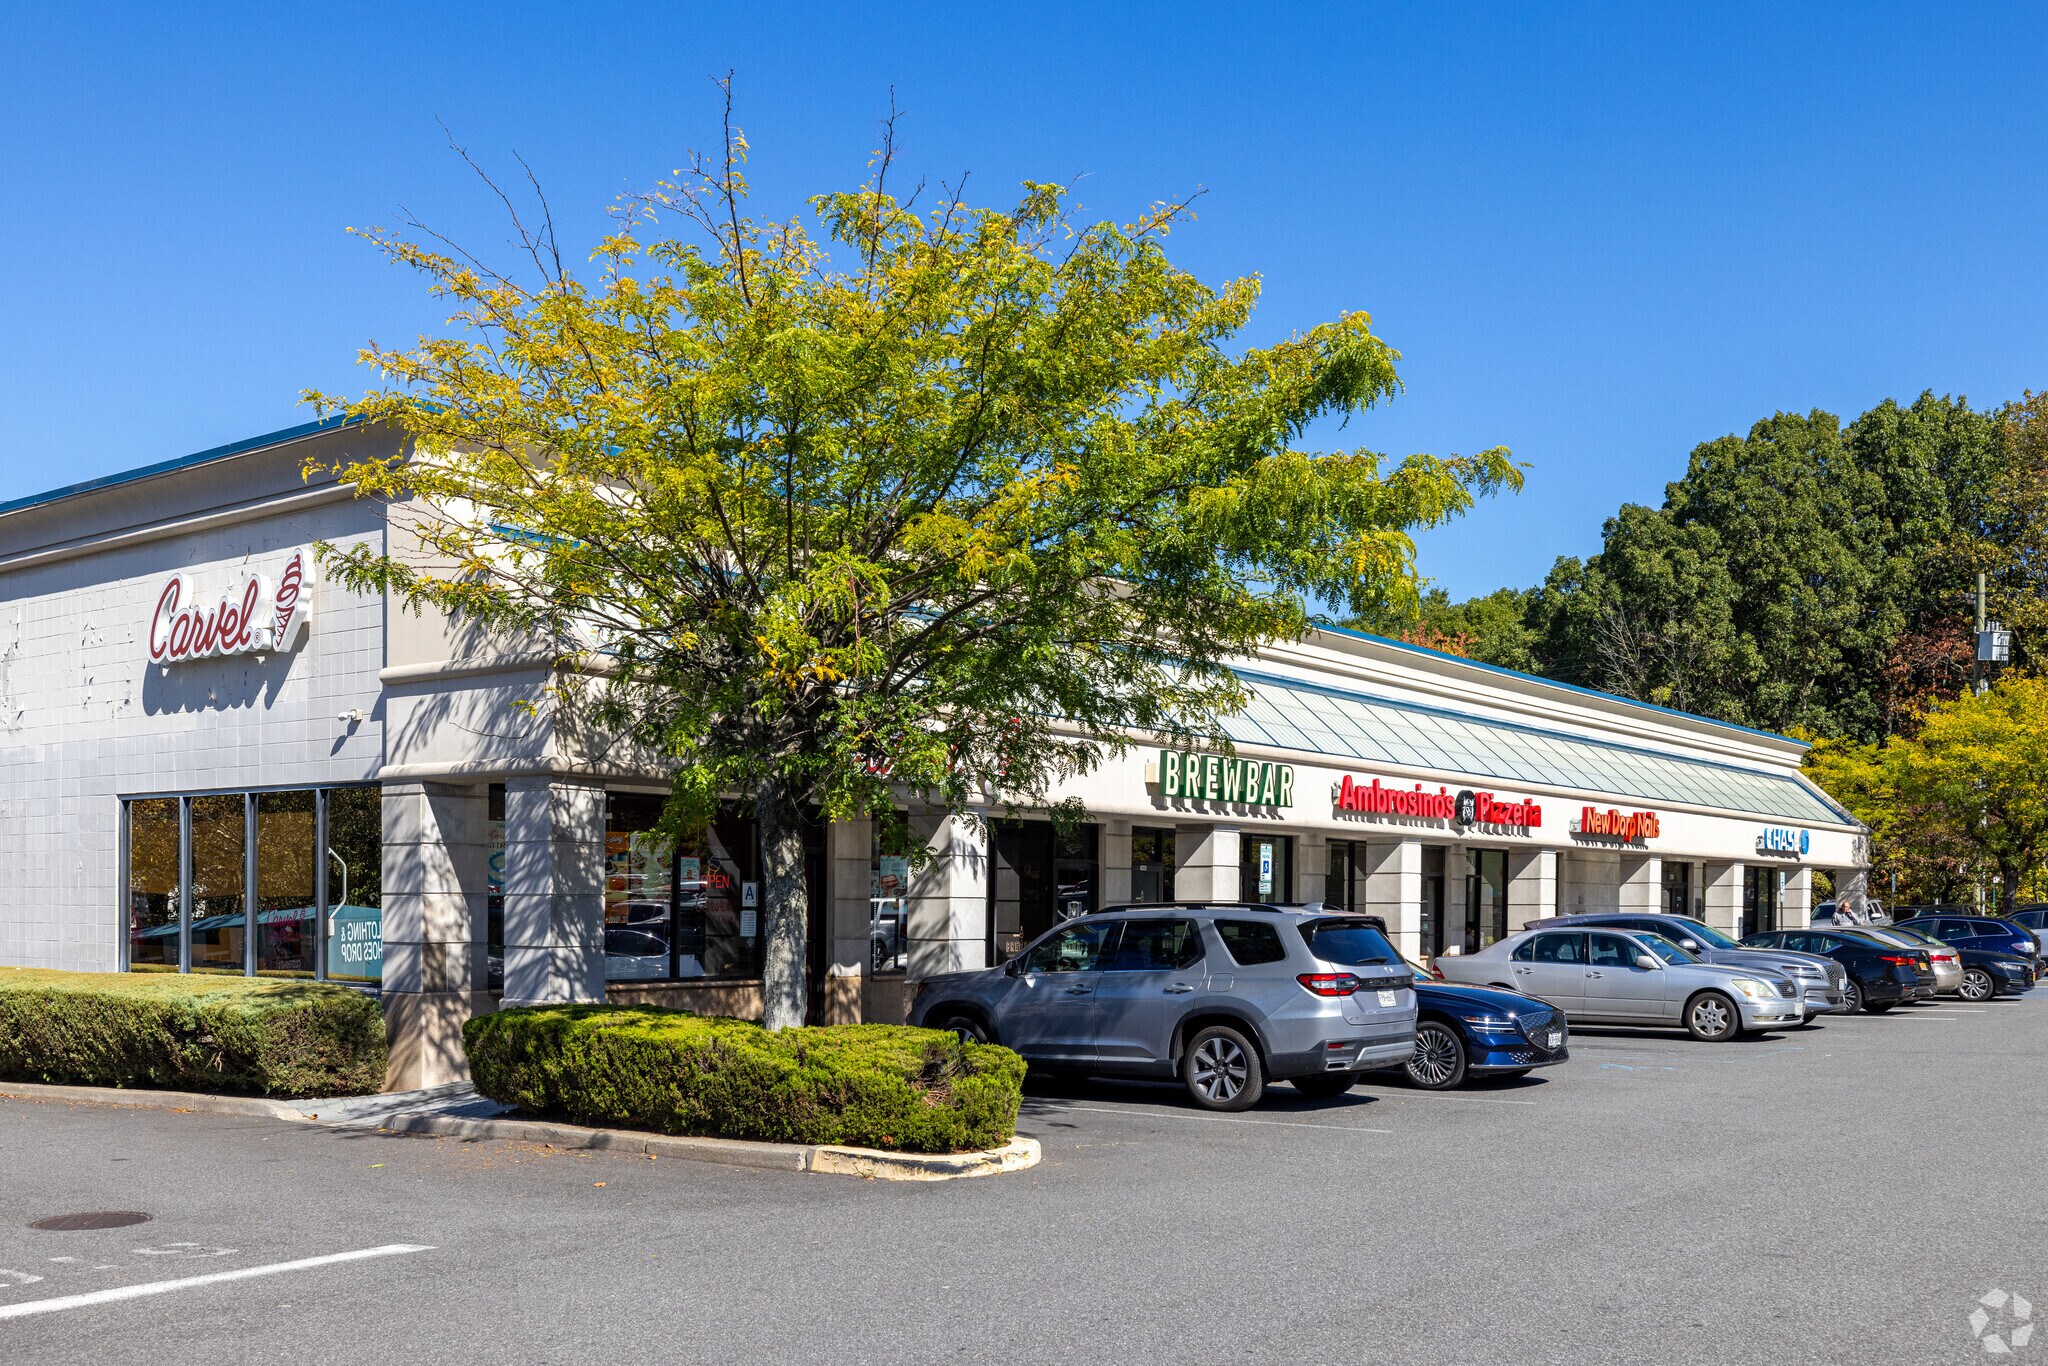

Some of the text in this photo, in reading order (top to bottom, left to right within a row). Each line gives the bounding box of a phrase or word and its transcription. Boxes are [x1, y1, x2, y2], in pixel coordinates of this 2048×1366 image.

[151, 577, 259, 659] Carvel
[1160, 750, 1293, 808] BREWBAR
[1339, 775, 1542, 827] Ambrosino's Pizzeria
[1582, 807, 1660, 843] New Dorp Nails
[1763, 828, 1799, 851] CHAS
[701, 875, 729, 888] OPEN
[744, 885, 754, 900] A
